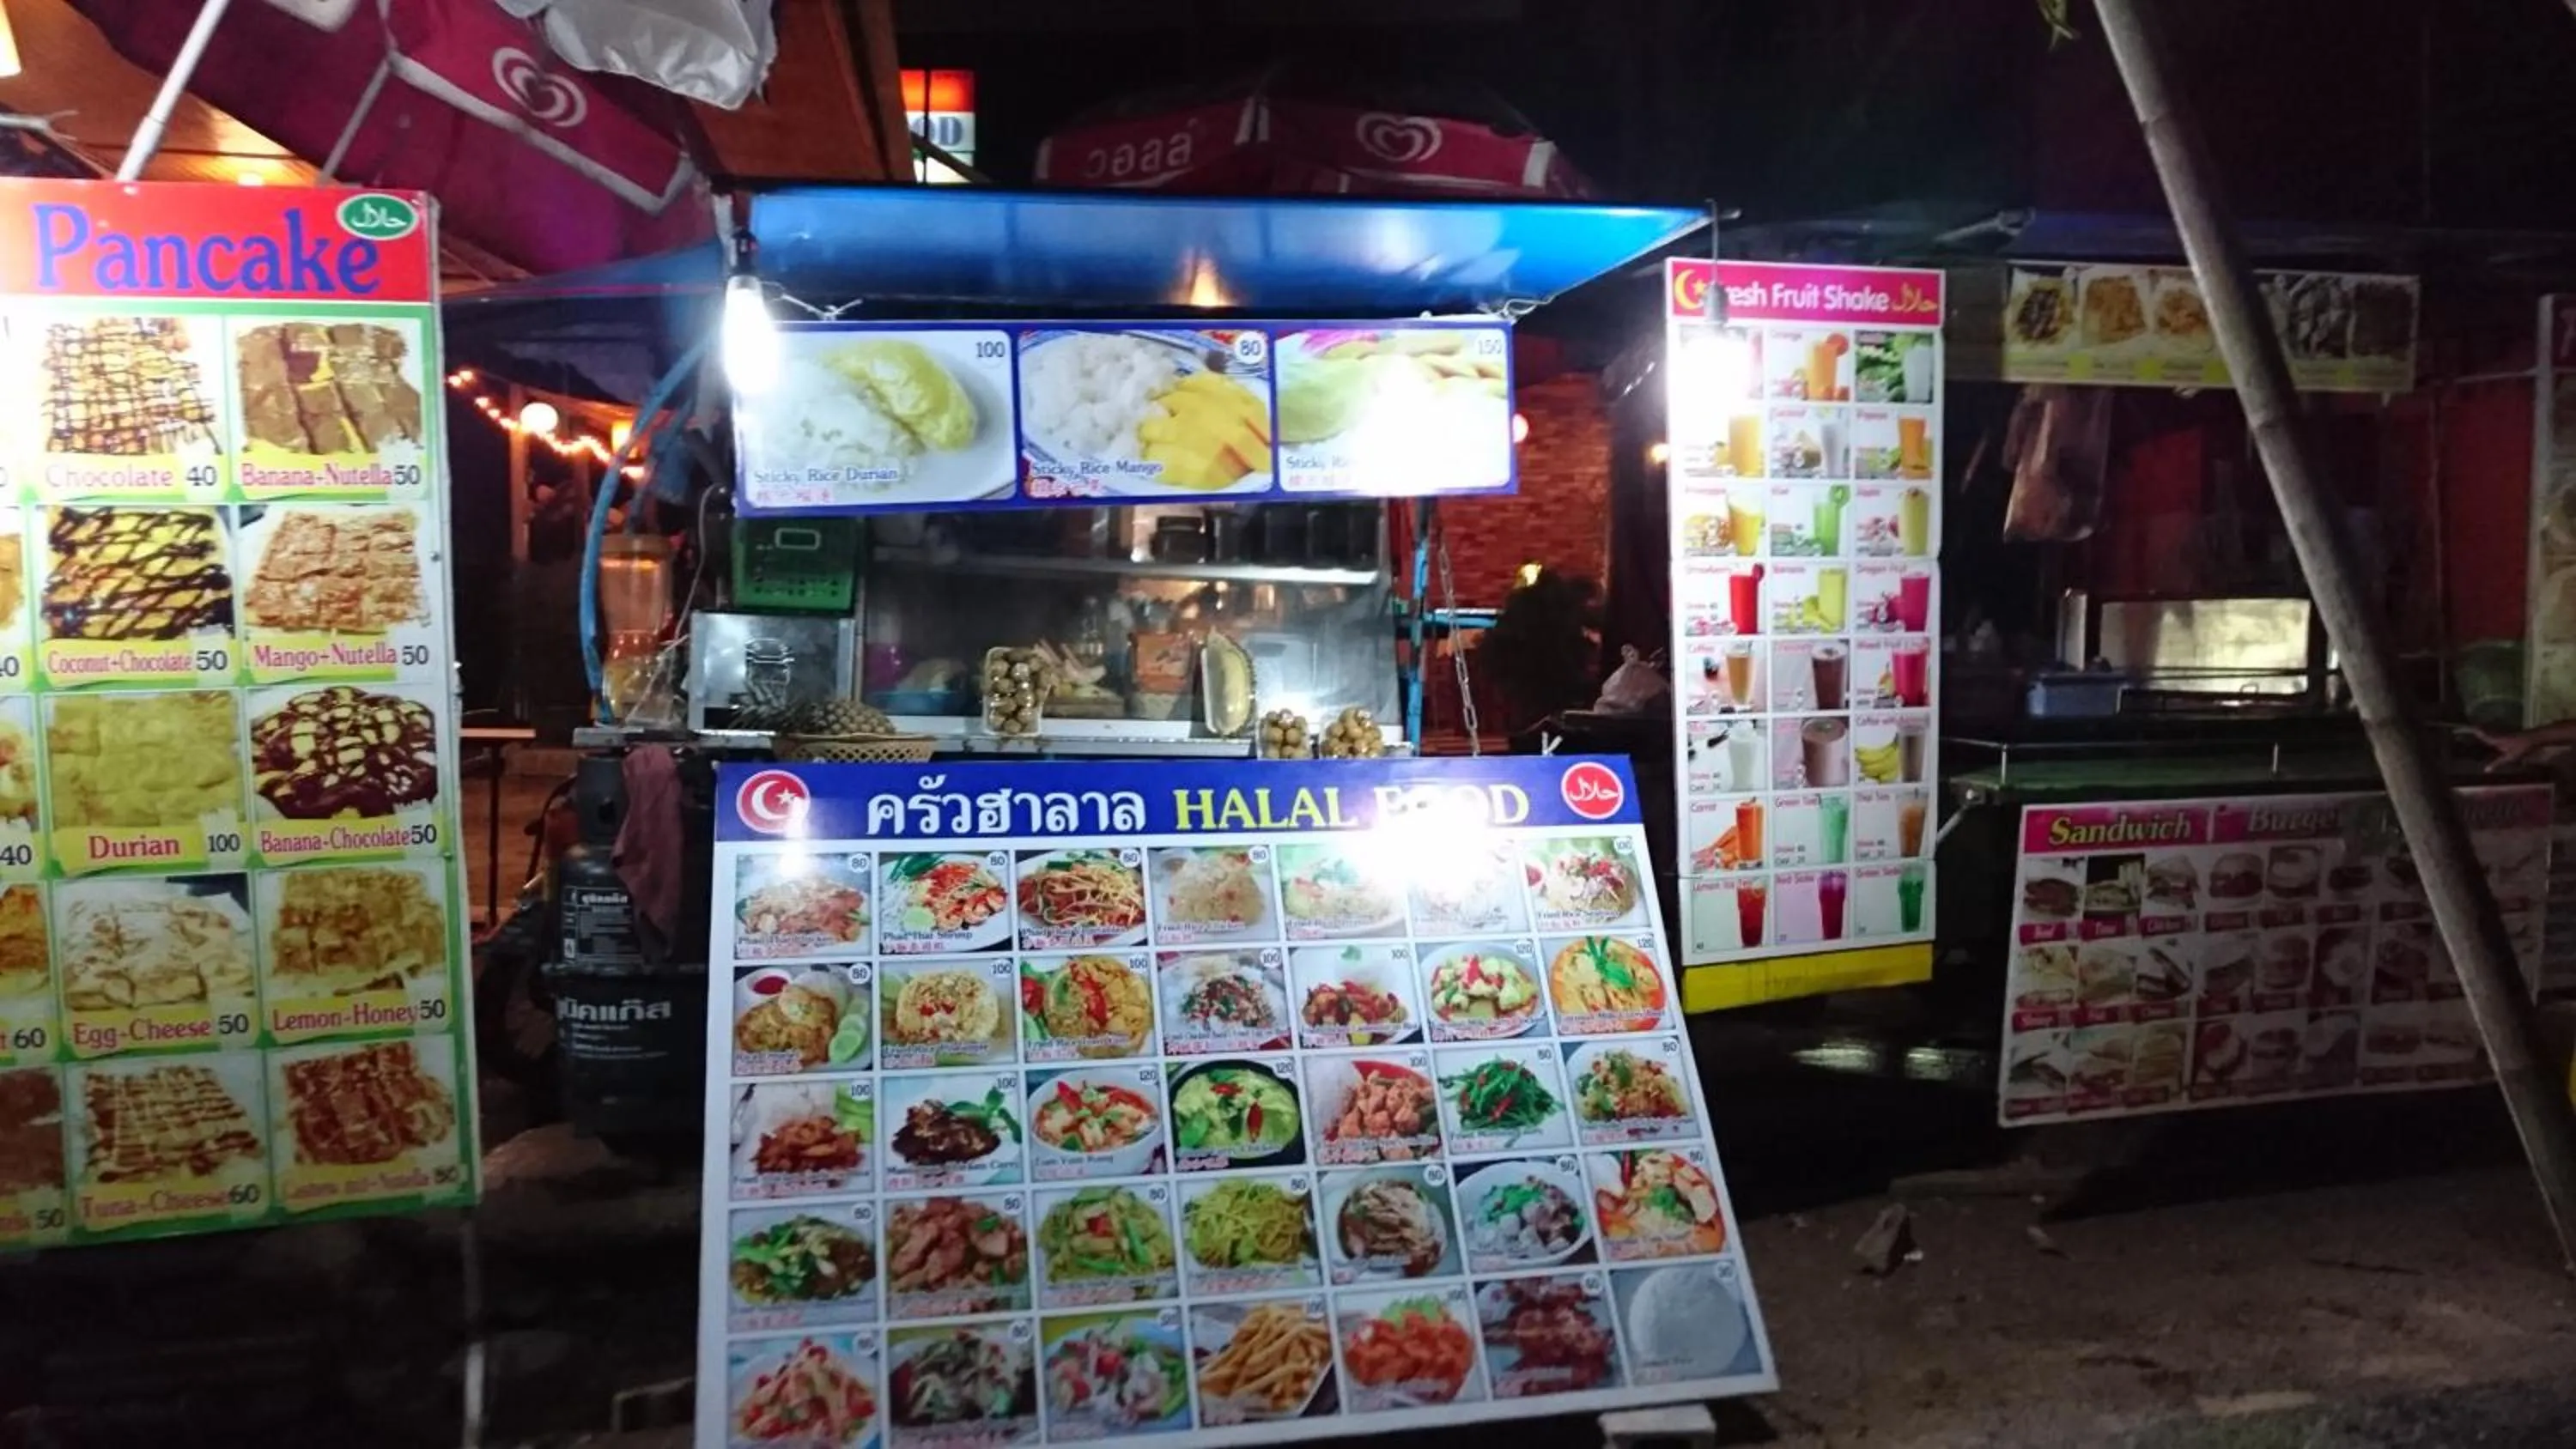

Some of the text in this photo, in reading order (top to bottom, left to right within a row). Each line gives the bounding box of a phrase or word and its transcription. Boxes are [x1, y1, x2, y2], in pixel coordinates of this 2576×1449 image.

[33, 203, 380, 294] Pancake
[1723, 281, 1891, 312] resh Fruit Shake
[976, 341, 1005, 358] 100
[1239, 340, 1261, 356] 80
[1477, 340, 1503, 355] 150
[186, 466, 217, 487] 40
[241, 464, 392, 488] Banana-Nutella
[392, 465, 420, 486] 50
[807, 469, 840, 482] Rice
[1080, 461, 1110, 474] Rice
[1115, 460, 1163, 474] Mango
[46, 468, 173, 488] Chocolate
[47, 651, 191, 673] Coconut-Chocolate
[196, 650, 228, 671] 50
[254, 643, 398, 669] Mango-Nutella
[403, 645, 428, 666] 50
[866, 774, 1147, 836] ครัวฮาลาล
[1171, 782, 1530, 831] HALAL FD
[410, 824, 437, 846] 50
[2048, 810, 2191, 845] Sandwich
[89, 835, 179, 858] Durian
[207, 834, 240, 853] 100
[261, 827, 410, 852] Banana-Chocolate
[0, 845, 32, 865] 40
[992, 963, 1012, 974] 100
[1129, 958, 1147, 969] 100
[1263, 953, 1280, 964] 100
[273, 1002, 416, 1033] Lemon-Honey
[419, 1000, 446, 1020] 50
[73, 1018, 211, 1048] Egg-Cheese
[219, 1014, 249, 1034] 50
[14, 1028, 46, 1049] 60
[1275, 1062, 1294, 1073] 120
[229, 1183, 260, 1204] 60
